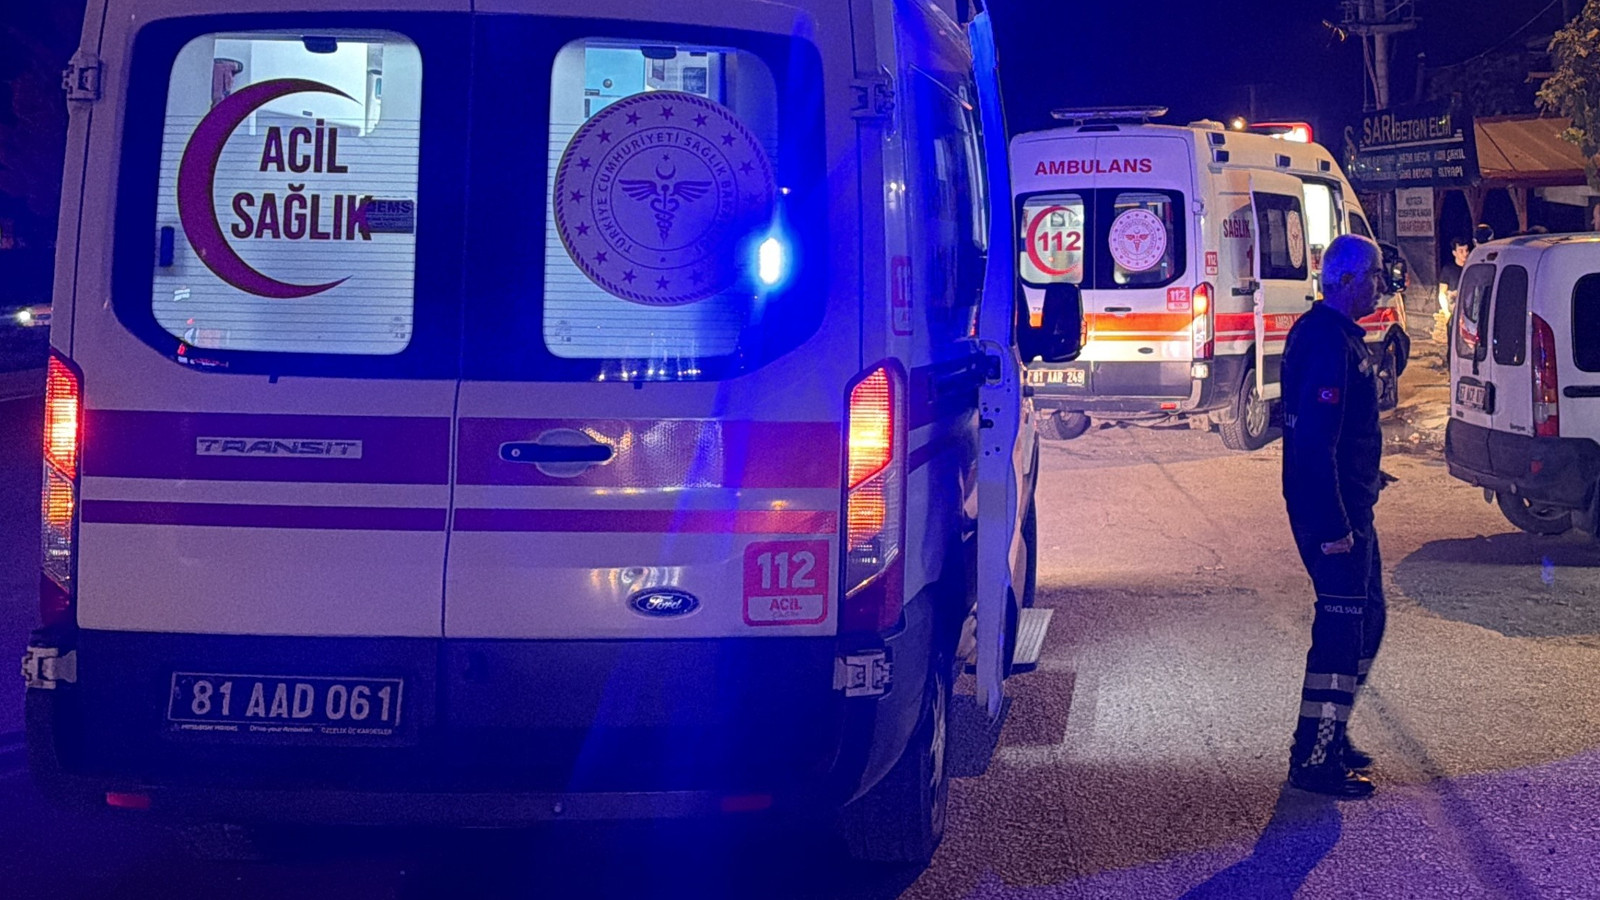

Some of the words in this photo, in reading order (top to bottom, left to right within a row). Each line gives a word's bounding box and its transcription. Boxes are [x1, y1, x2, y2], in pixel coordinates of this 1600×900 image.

[259, 118, 348, 173] ACİL
[686, 136, 727, 177] SAĞLIK
[598, 131, 680, 193] CUMHURİYETİ
[1034, 158, 1152, 176] AMBULANS
[231, 183, 373, 240] SAĞLIK
[597, 198, 633, 255] TÜRKİYE
[1037, 231, 1082, 251] 112
[1223, 216, 1251, 239] SAĞLIK
[1169, 289, 1187, 302] 112
[198, 439, 357, 455] TRANSIT
[757, 550, 816, 589] 112
[646, 595, 683, 610] Ford
[769, 597, 803, 611] ACİL
[191, 680, 233, 716] 81
[245, 682, 315, 719] AAD
[325, 684, 392, 721] 061
